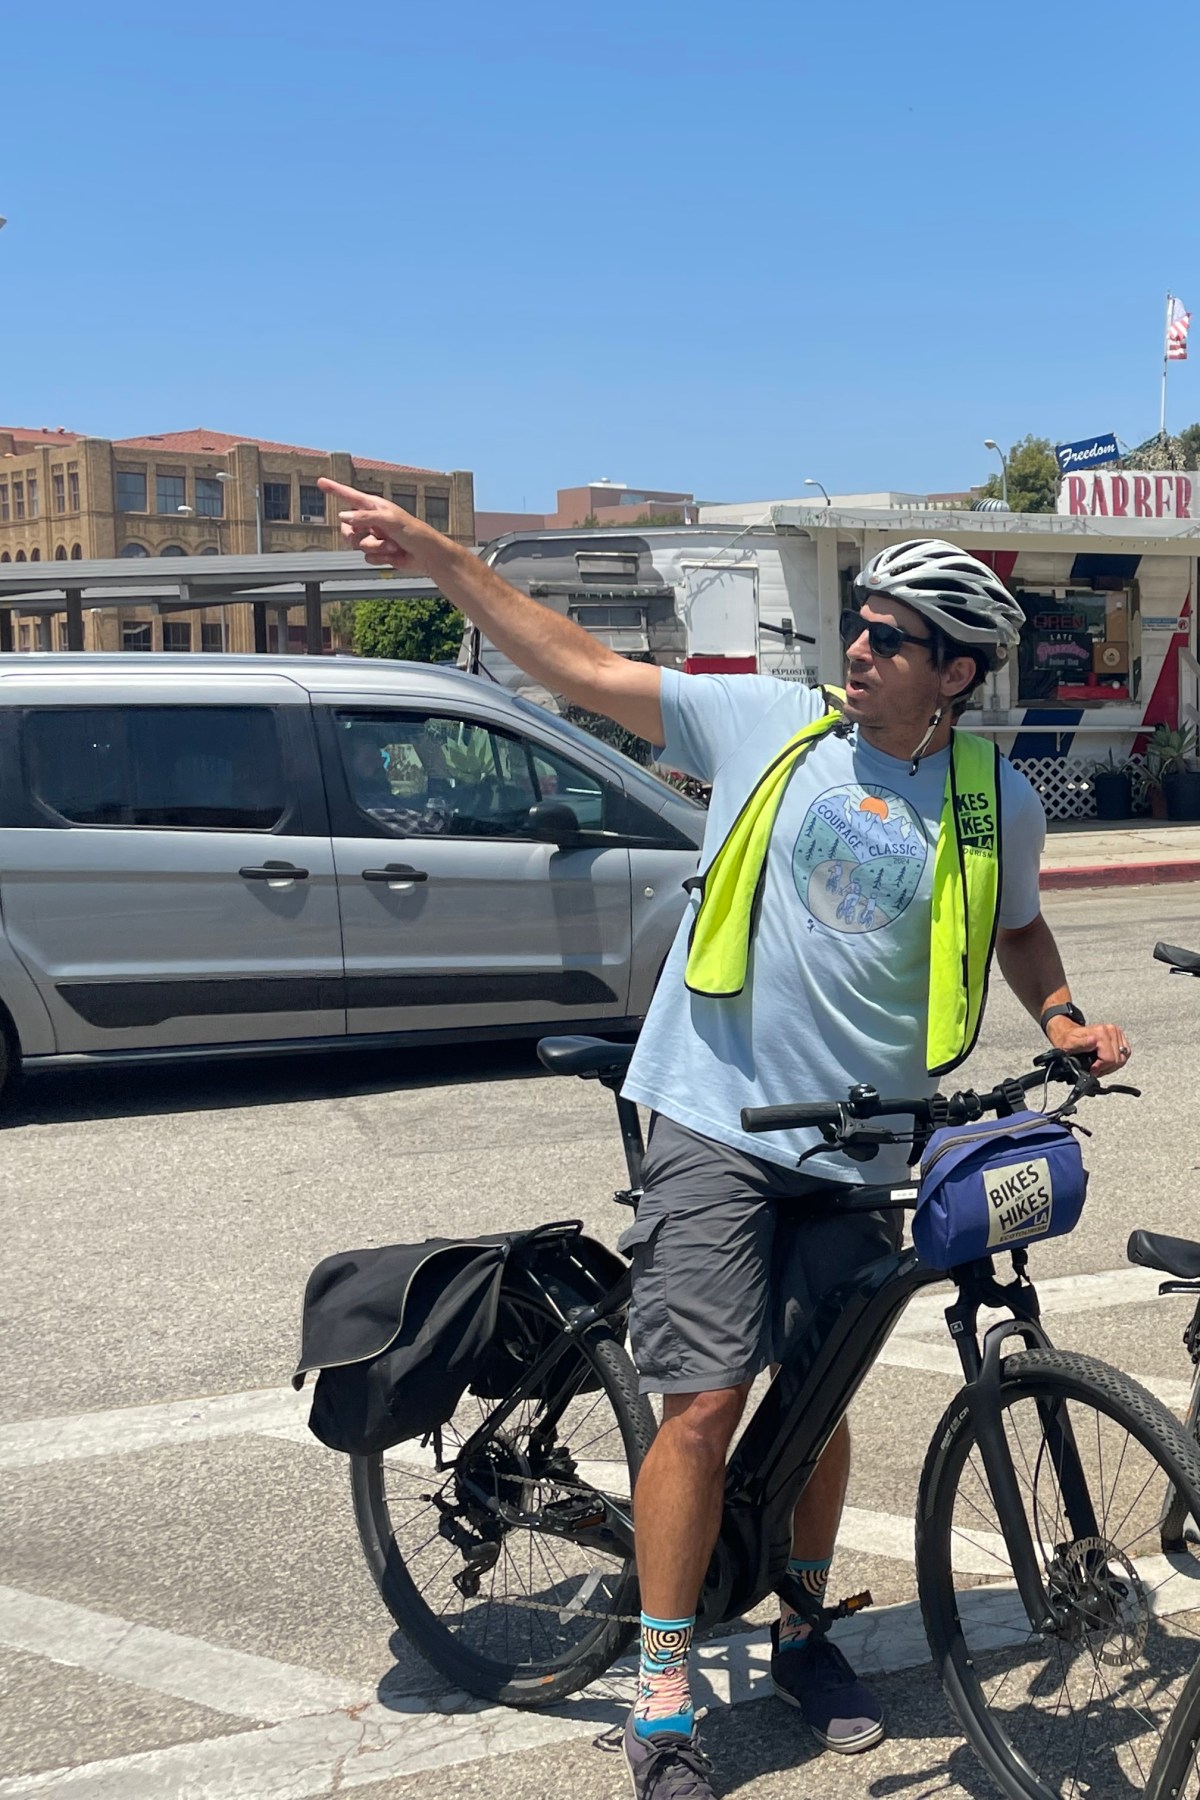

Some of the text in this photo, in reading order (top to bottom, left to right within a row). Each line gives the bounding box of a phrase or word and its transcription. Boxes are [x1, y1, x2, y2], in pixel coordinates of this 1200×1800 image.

[1059, 443, 1116, 468] Freedom
[1068, 475, 1192, 518] BARBER
[1034, 615, 1083, 629] OPEN
[1050, 633, 1073, 641] LATE
[772, 668, 815, 676] EXPLOSIVES
[817, 804, 918, 857] COURAGE CLASSIC
[978, 836, 993, 849] LA
[893, 857, 910, 865] 2024
[989, 1164, 1039, 1209] BIKES
[999, 1186, 1049, 1231] HIKES
[1033, 1212, 1048, 1226] LA
[999, 1225, 1048, 1242] ECOTOURISM
